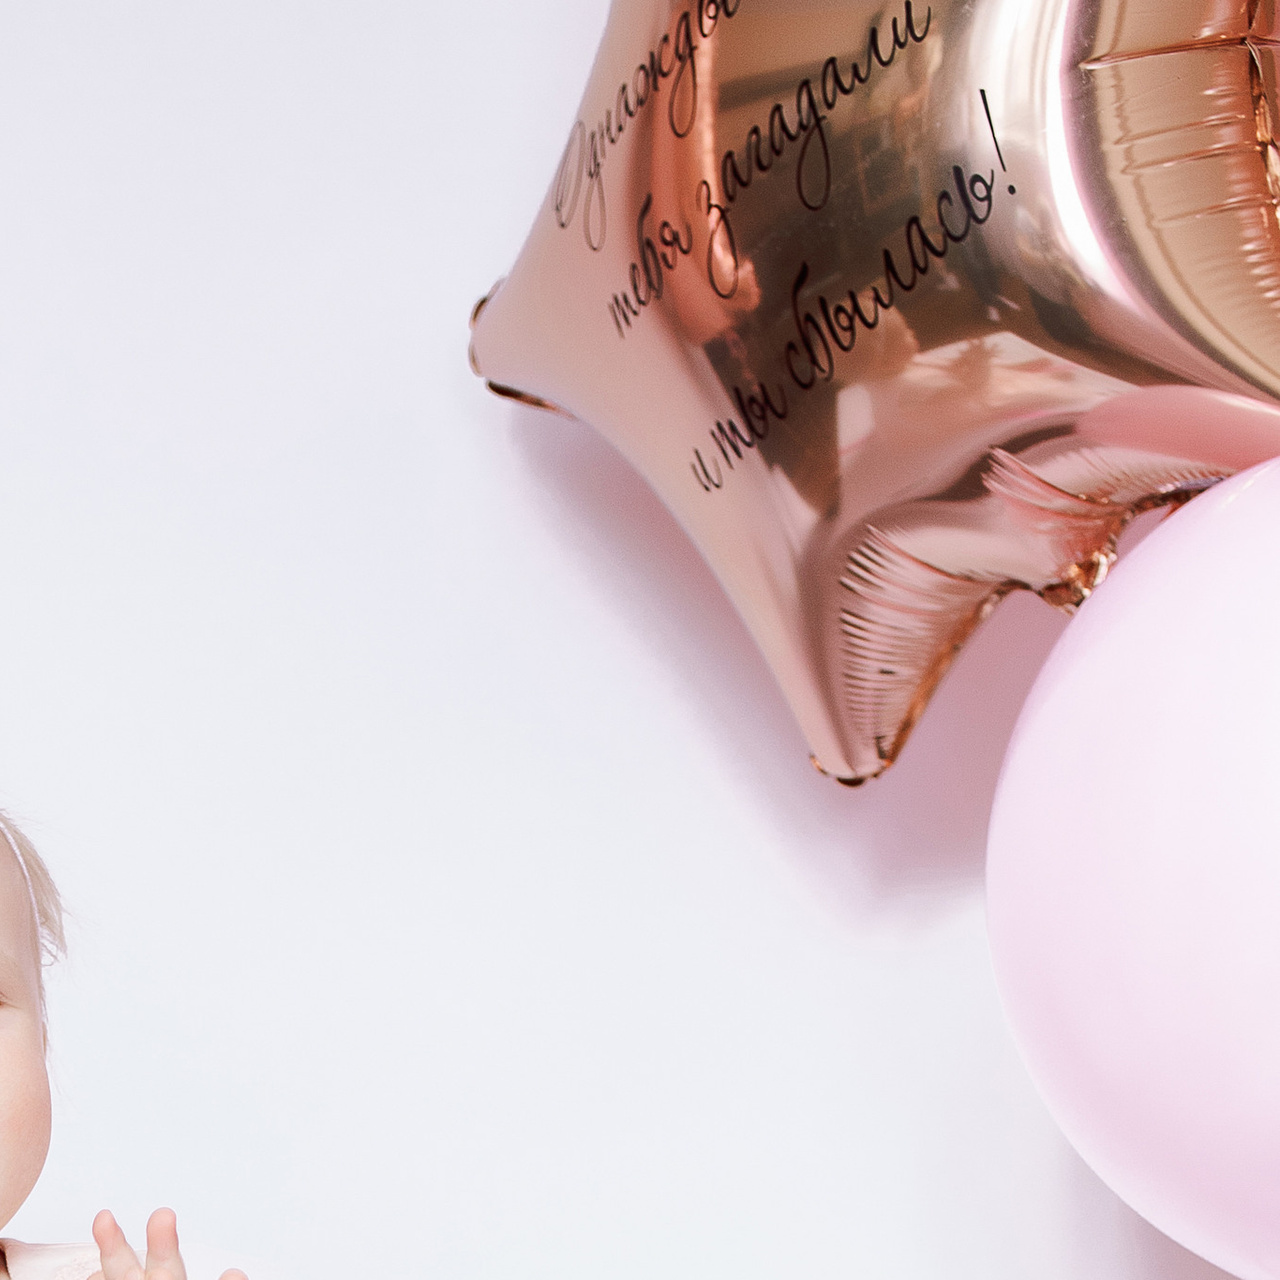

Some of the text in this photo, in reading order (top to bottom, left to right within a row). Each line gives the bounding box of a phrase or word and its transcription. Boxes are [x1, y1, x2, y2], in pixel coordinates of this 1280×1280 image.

[608, 0, 932, 340] тебя загадали
[710, 383, 789, 467] ты
[784, 88, 1016, 390] сбылась!
